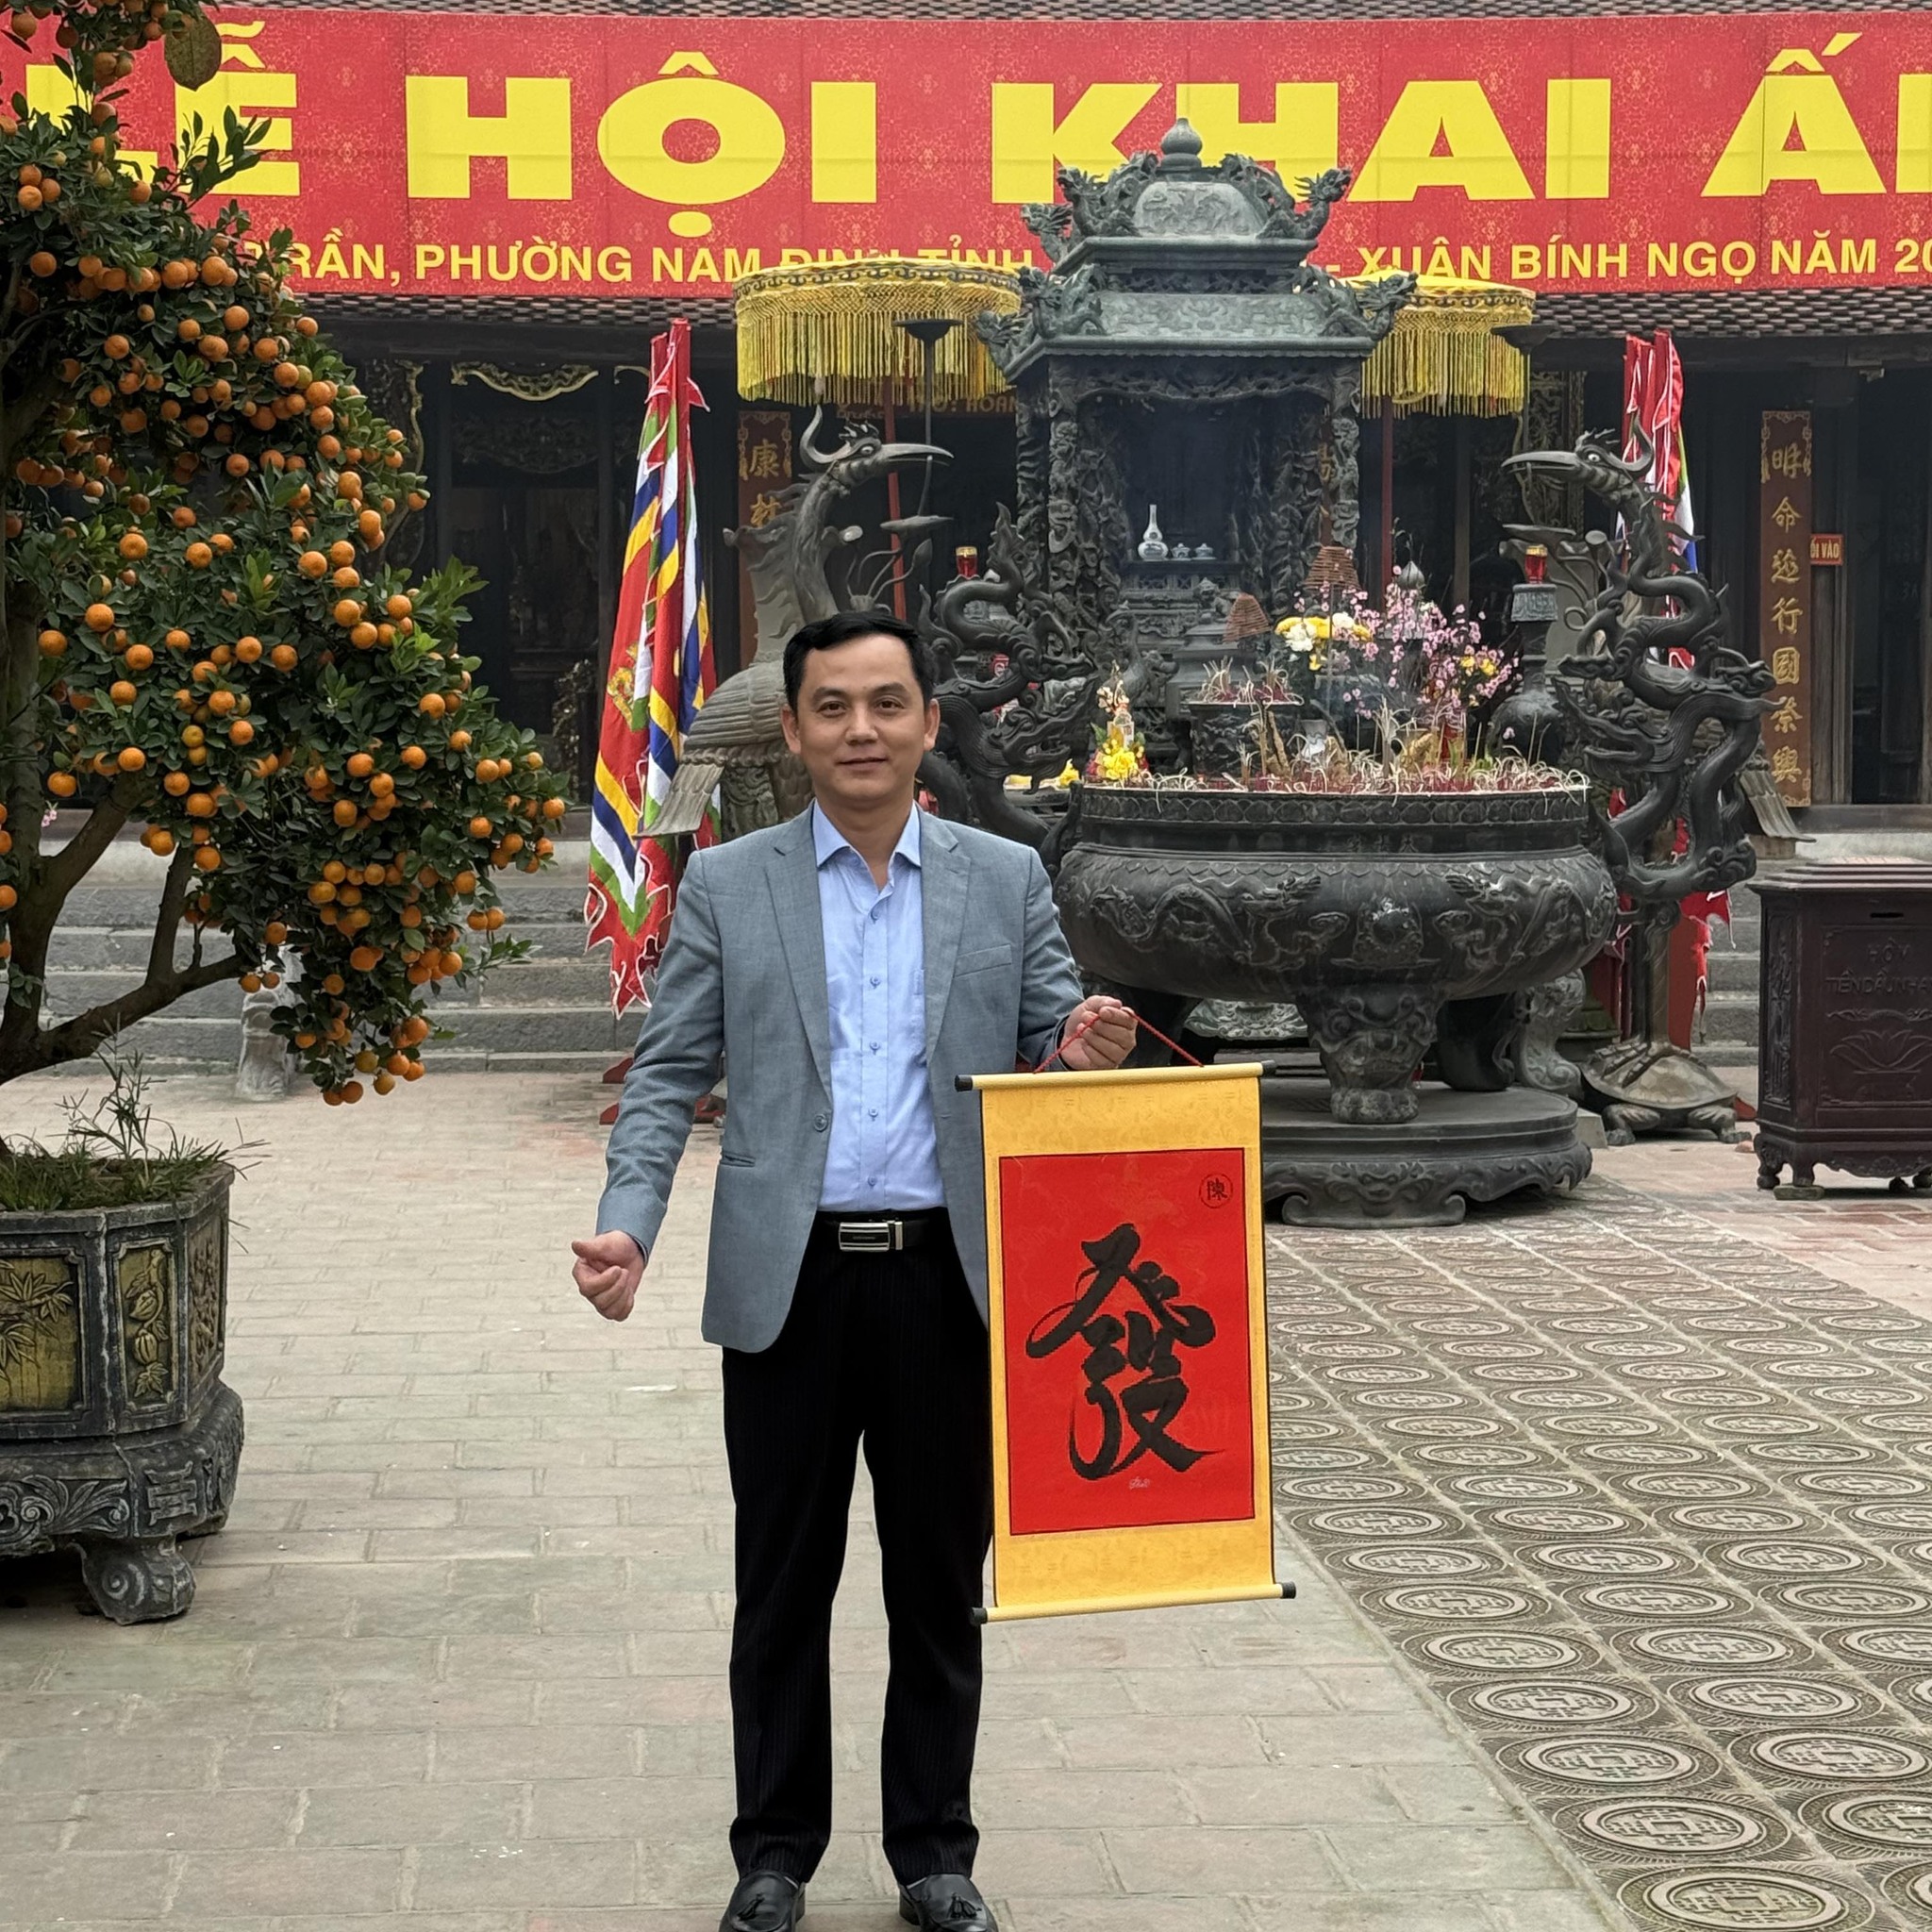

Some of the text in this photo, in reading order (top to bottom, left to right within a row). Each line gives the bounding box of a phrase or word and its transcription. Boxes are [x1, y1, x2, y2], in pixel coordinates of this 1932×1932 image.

[405, 51, 877, 239] HỘI
[991, 78, 1612, 204] KHAI
[415, 235, 632, 282] PHƯỜNG
[652, 247, 760, 282] NAM
[1511, 234, 1628, 280] BÍNH
[1648, 241, 1757, 285] NGỌ
[1771, 229, 1877, 275] NĂM
